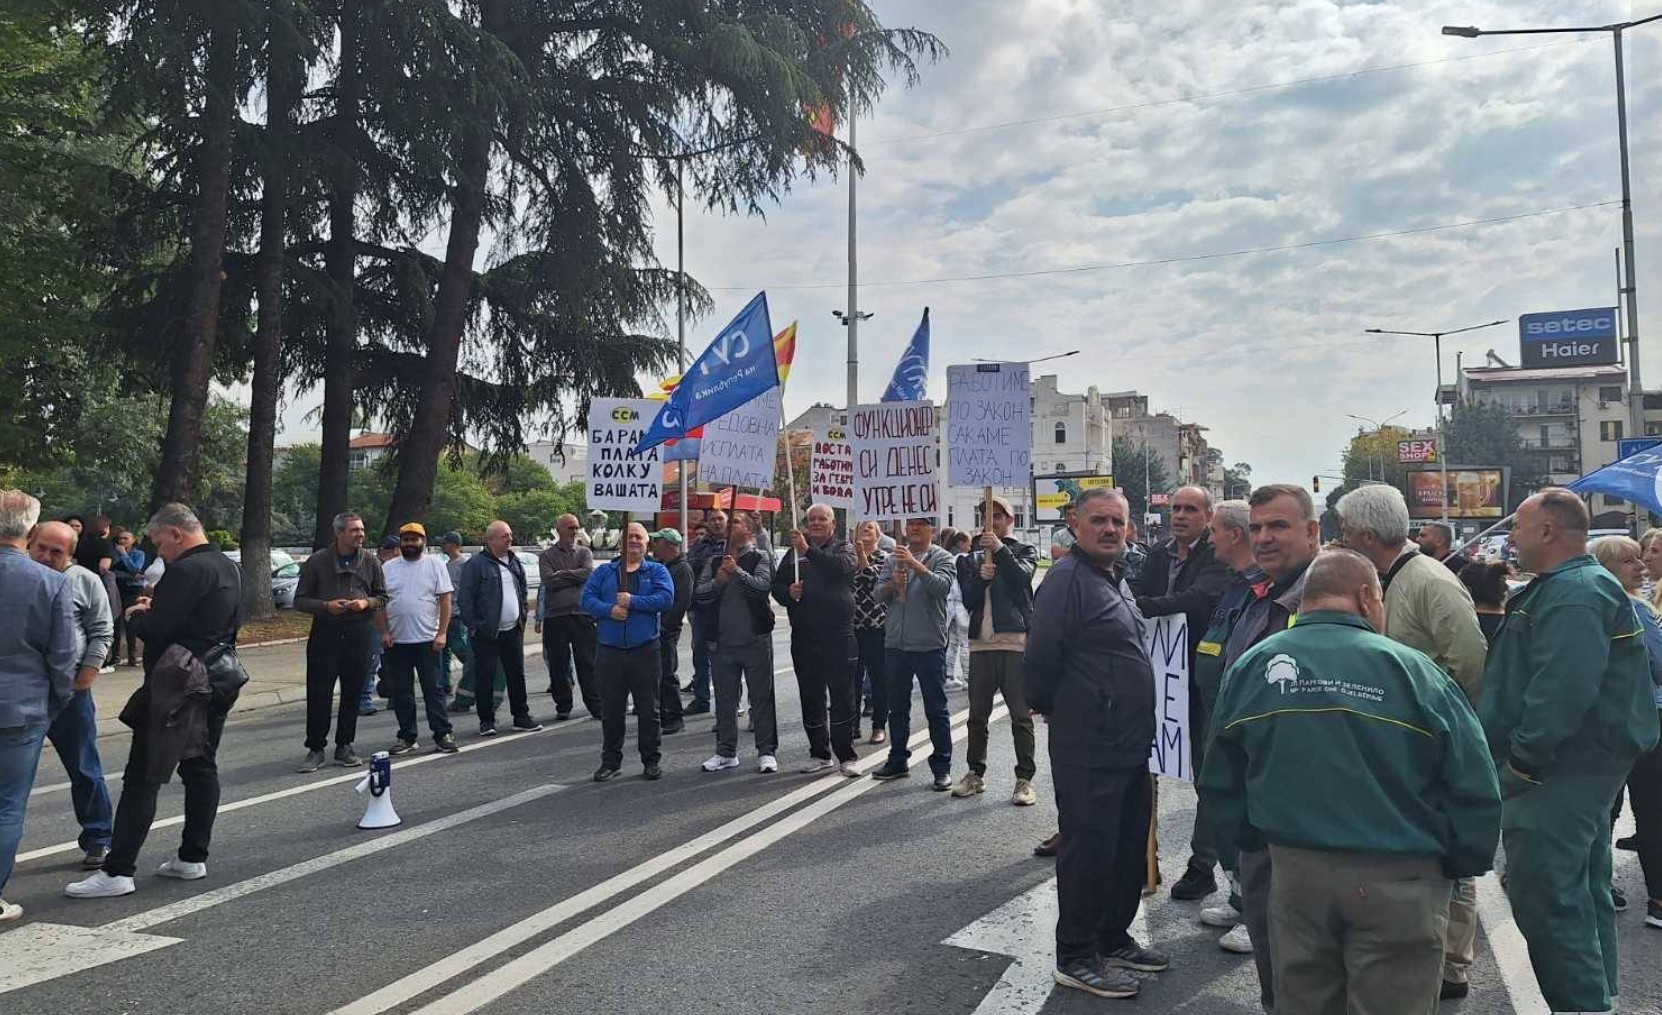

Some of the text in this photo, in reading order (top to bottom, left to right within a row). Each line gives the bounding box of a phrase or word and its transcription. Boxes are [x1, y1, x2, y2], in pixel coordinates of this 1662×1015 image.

[1527, 318, 1611, 334] setec
[1542, 341, 1599, 358] Haier
[949, 369, 1029, 392] РАБОТИМЕ
[949, 400, 1023, 421] ПО ЗАКОН
[716, 413, 777, 436] ЕДОВНА
[948, 424, 1010, 445] САКАМЕ
[702, 440, 765, 461] ИСПЛАТА
[815, 442, 851, 456] ДОСТА
[1399, 441, 1434, 453] SEX
[860, 445, 932, 478] СИ ДЕНЕС
[949, 447, 1028, 467] ПЛАТА ПО
[593, 463, 651, 478] КОЛКУ
[700, 463, 769, 488] НА ПЛАТА
[812, 472, 826, 483] ЗА
[962, 467, 1012, 486] ЗАКОН
[594, 483, 658, 498] ВАШАТА
[813, 484, 819, 494] И
[863, 483, 937, 515] УТРЕ НЕ СИ
